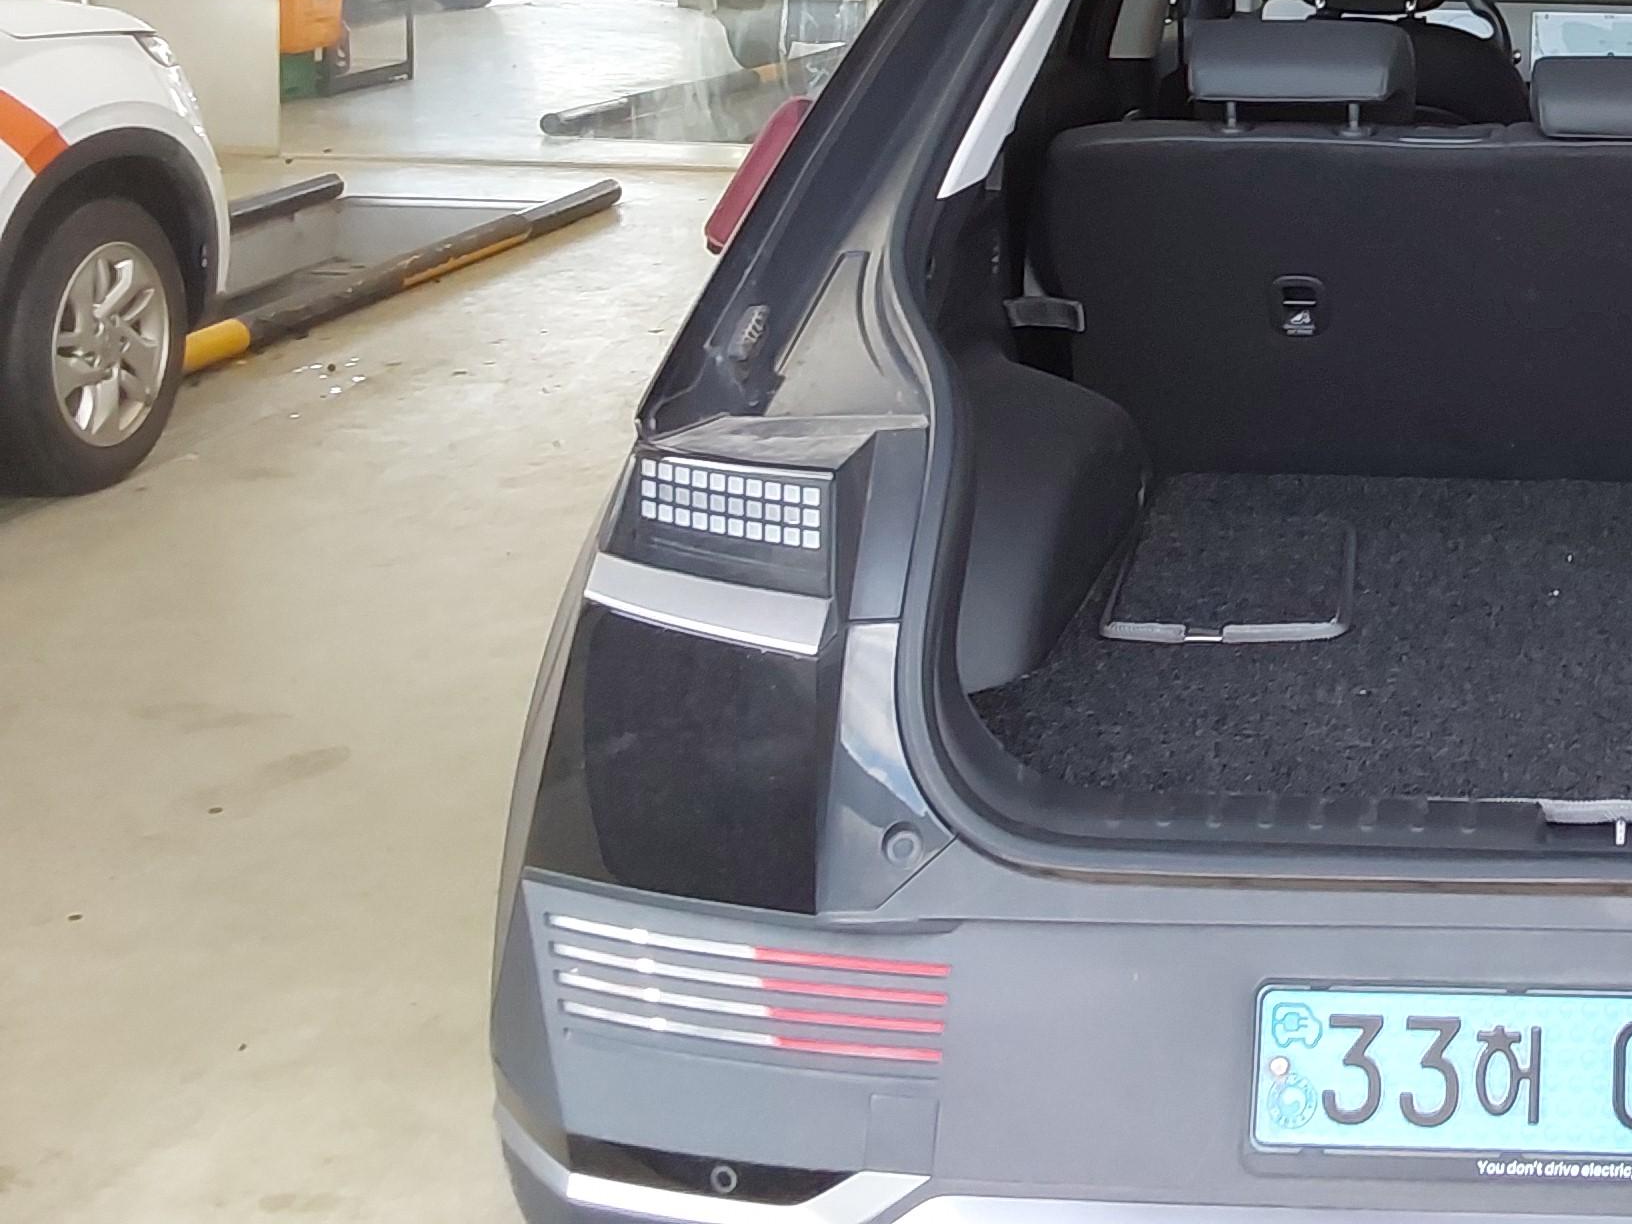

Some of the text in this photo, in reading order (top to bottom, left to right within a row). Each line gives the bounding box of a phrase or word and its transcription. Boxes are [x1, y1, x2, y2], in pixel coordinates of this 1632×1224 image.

[1321, 1013, 1542, 1128] 33허
[1477, 1160, 1505, 1176] You
[1507, 1161, 1543, 1176] don't
[1545, 1162, 1579, 1177] drive
